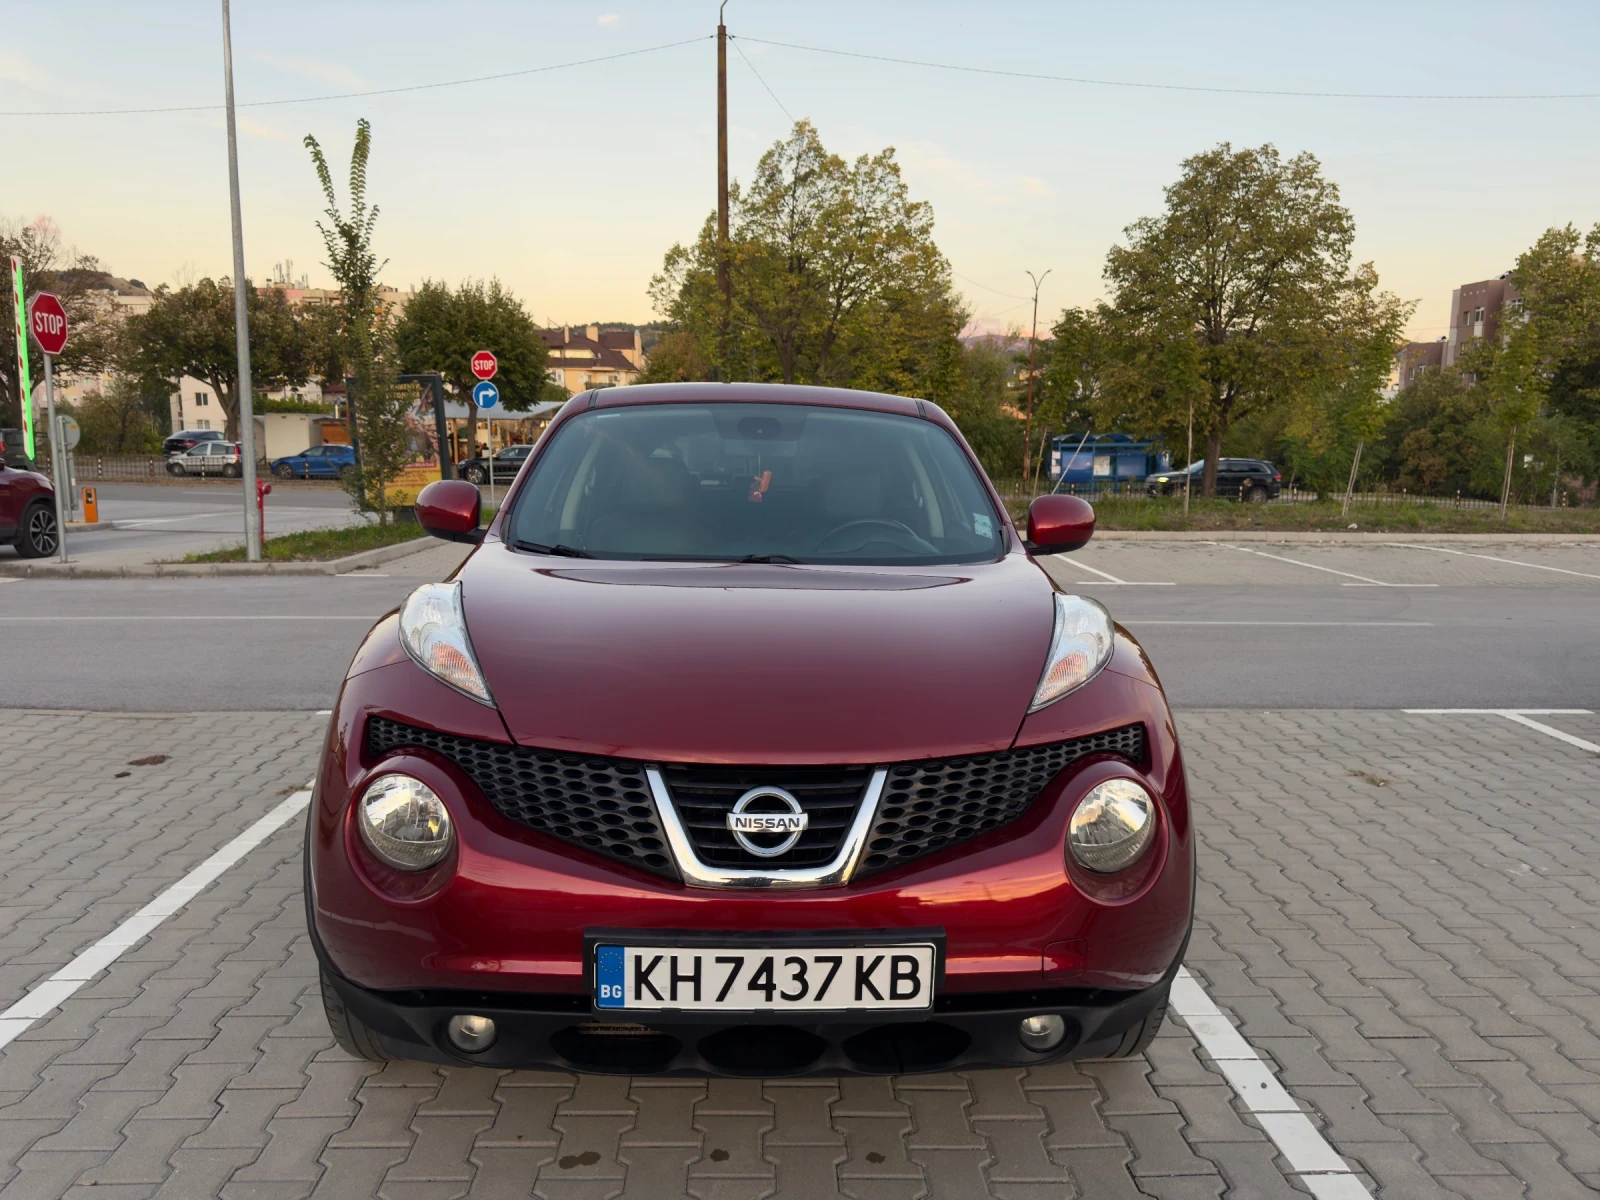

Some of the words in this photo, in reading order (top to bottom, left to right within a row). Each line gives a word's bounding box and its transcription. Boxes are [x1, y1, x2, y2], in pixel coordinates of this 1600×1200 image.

[35, 311, 64, 336] STOP
[474, 359, 495, 371] STOP
[735, 817, 800, 829] NISSAN
[600, 984, 622, 999] BG
